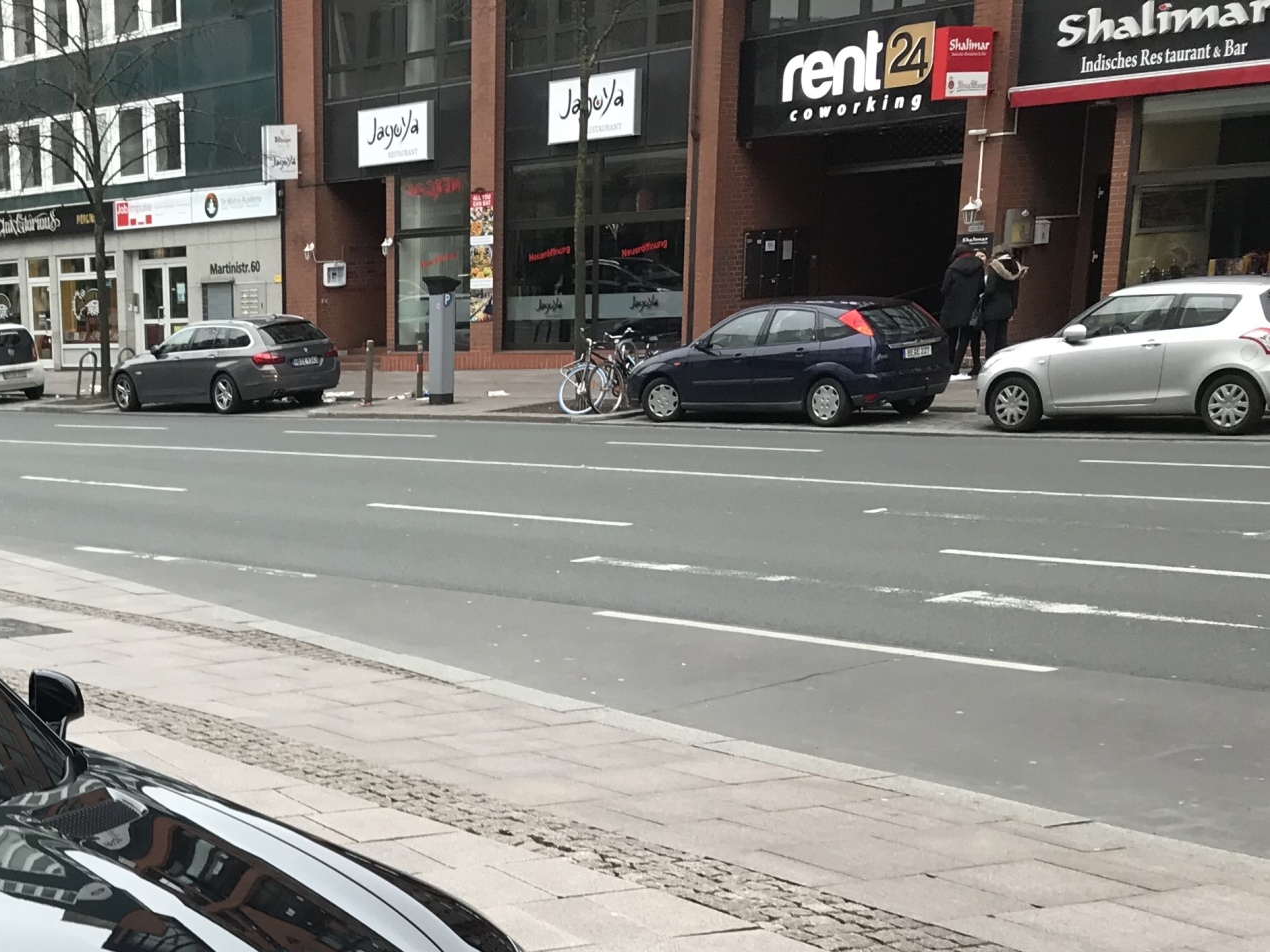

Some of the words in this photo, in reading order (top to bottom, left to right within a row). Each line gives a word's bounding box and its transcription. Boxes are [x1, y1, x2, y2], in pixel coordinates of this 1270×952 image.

[1057, 0, 1270, 48] Shalimar
[949, 37, 990, 51] Shalimar
[1081, 51, 1138, 73] Indisches
[1213, 46, 1222, 57] &
[1225, 38, 1248, 57] Bar
[782, 29, 884, 103] rent
[889, 31, 929, 79] 24
[789, 93, 922, 122] coworking
[388, 148, 419, 158] RESTAURANT
[528, 245, 571, 262] Neueröffnung
[621, 239, 668, 258] Neueröffnung
